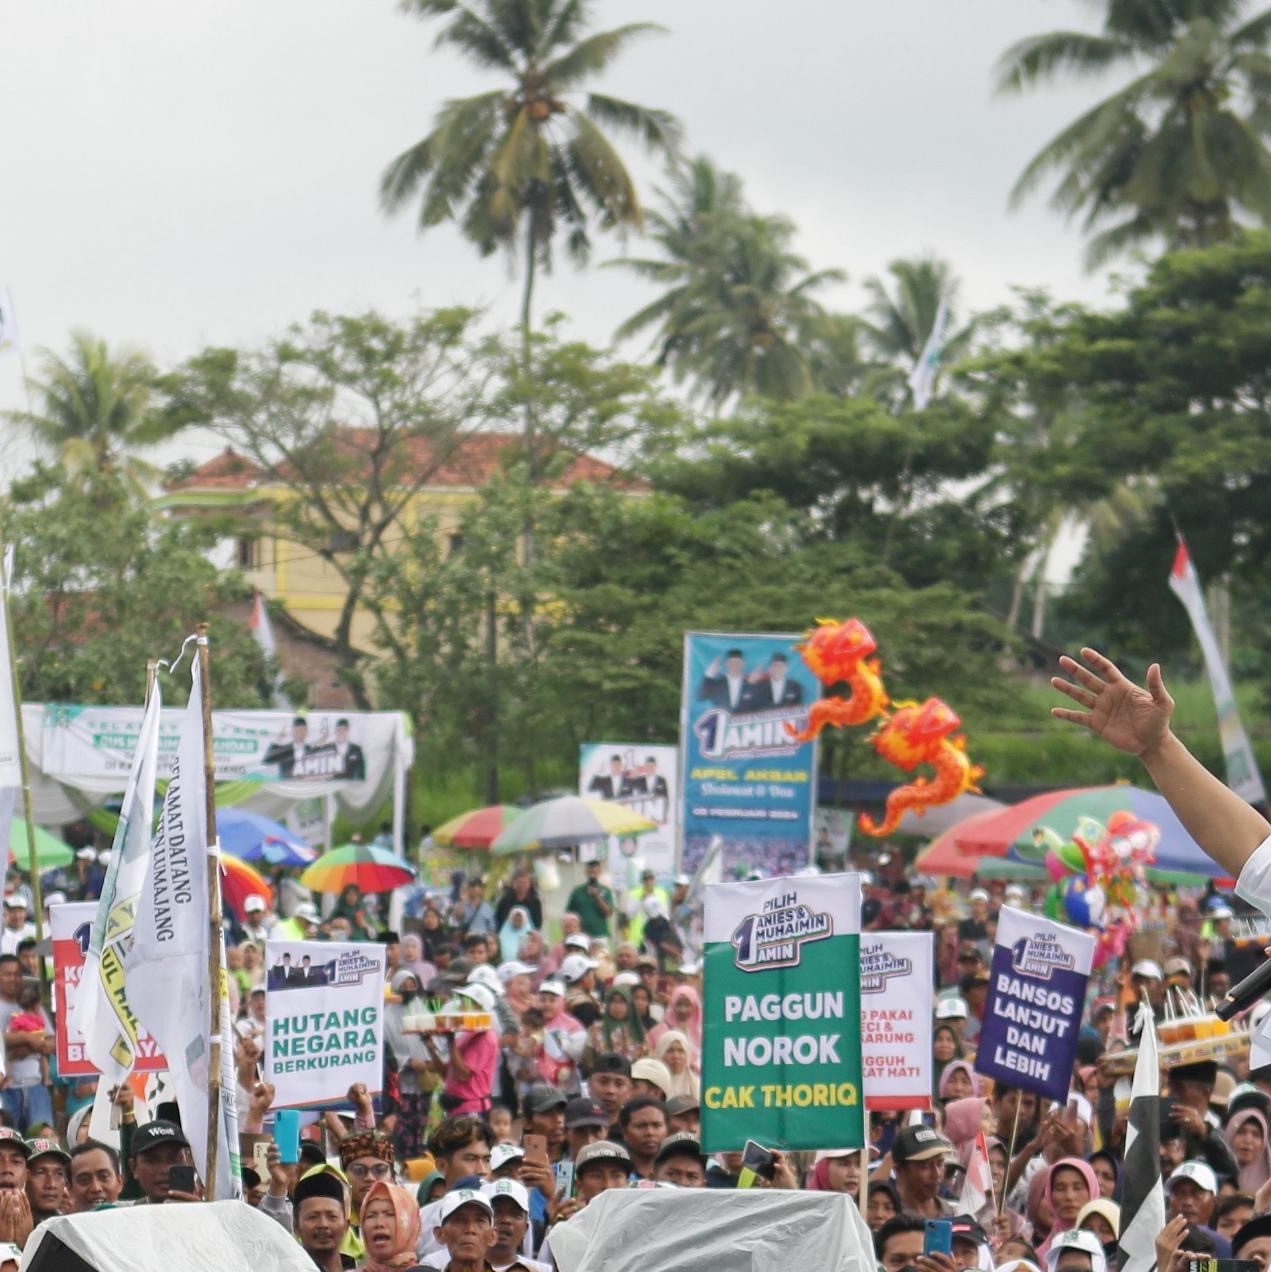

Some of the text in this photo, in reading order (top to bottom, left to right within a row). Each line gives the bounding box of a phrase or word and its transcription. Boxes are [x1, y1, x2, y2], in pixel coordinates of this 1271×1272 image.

[698, 712, 726, 756] 1
[725, 719, 796, 748] AMIN
[168, 832, 192, 905] DATANG
[152, 849, 176, 943] LUMAJANG
[762, 891, 797, 913] PILIH
[755, 914, 825, 942] MUHAIMIN
[756, 909, 794, 928] ANIES
[757, 943, 794, 963] AMIN
[860, 944, 883, 955] ILIH
[860, 955, 880, 965] NIES
[860, 958, 905, 973] UHAIMIN
[860, 977, 879, 989] MIN
[996, 974, 1074, 1016] BANSOS
[724, 991, 844, 1023] PAGGUN
[870, 1010, 913, 1021] PAKAI
[993, 996, 1070, 1038] LANJUT
[273, 1007, 377, 1037] HUTANG
[860, 1021, 893, 1032] ECI &
[273, 1028, 377, 1058] NEGARA
[723, 1034, 841, 1067] NOROK
[1006, 1025, 1047, 1056] DAN
[273, 1050, 376, 1074] BERKURANG
[887, 1067, 920, 1078] HATI
[993, 1046, 1051, 1082] LEBIH
[704, 1082, 858, 1110] CAK THORIQ
